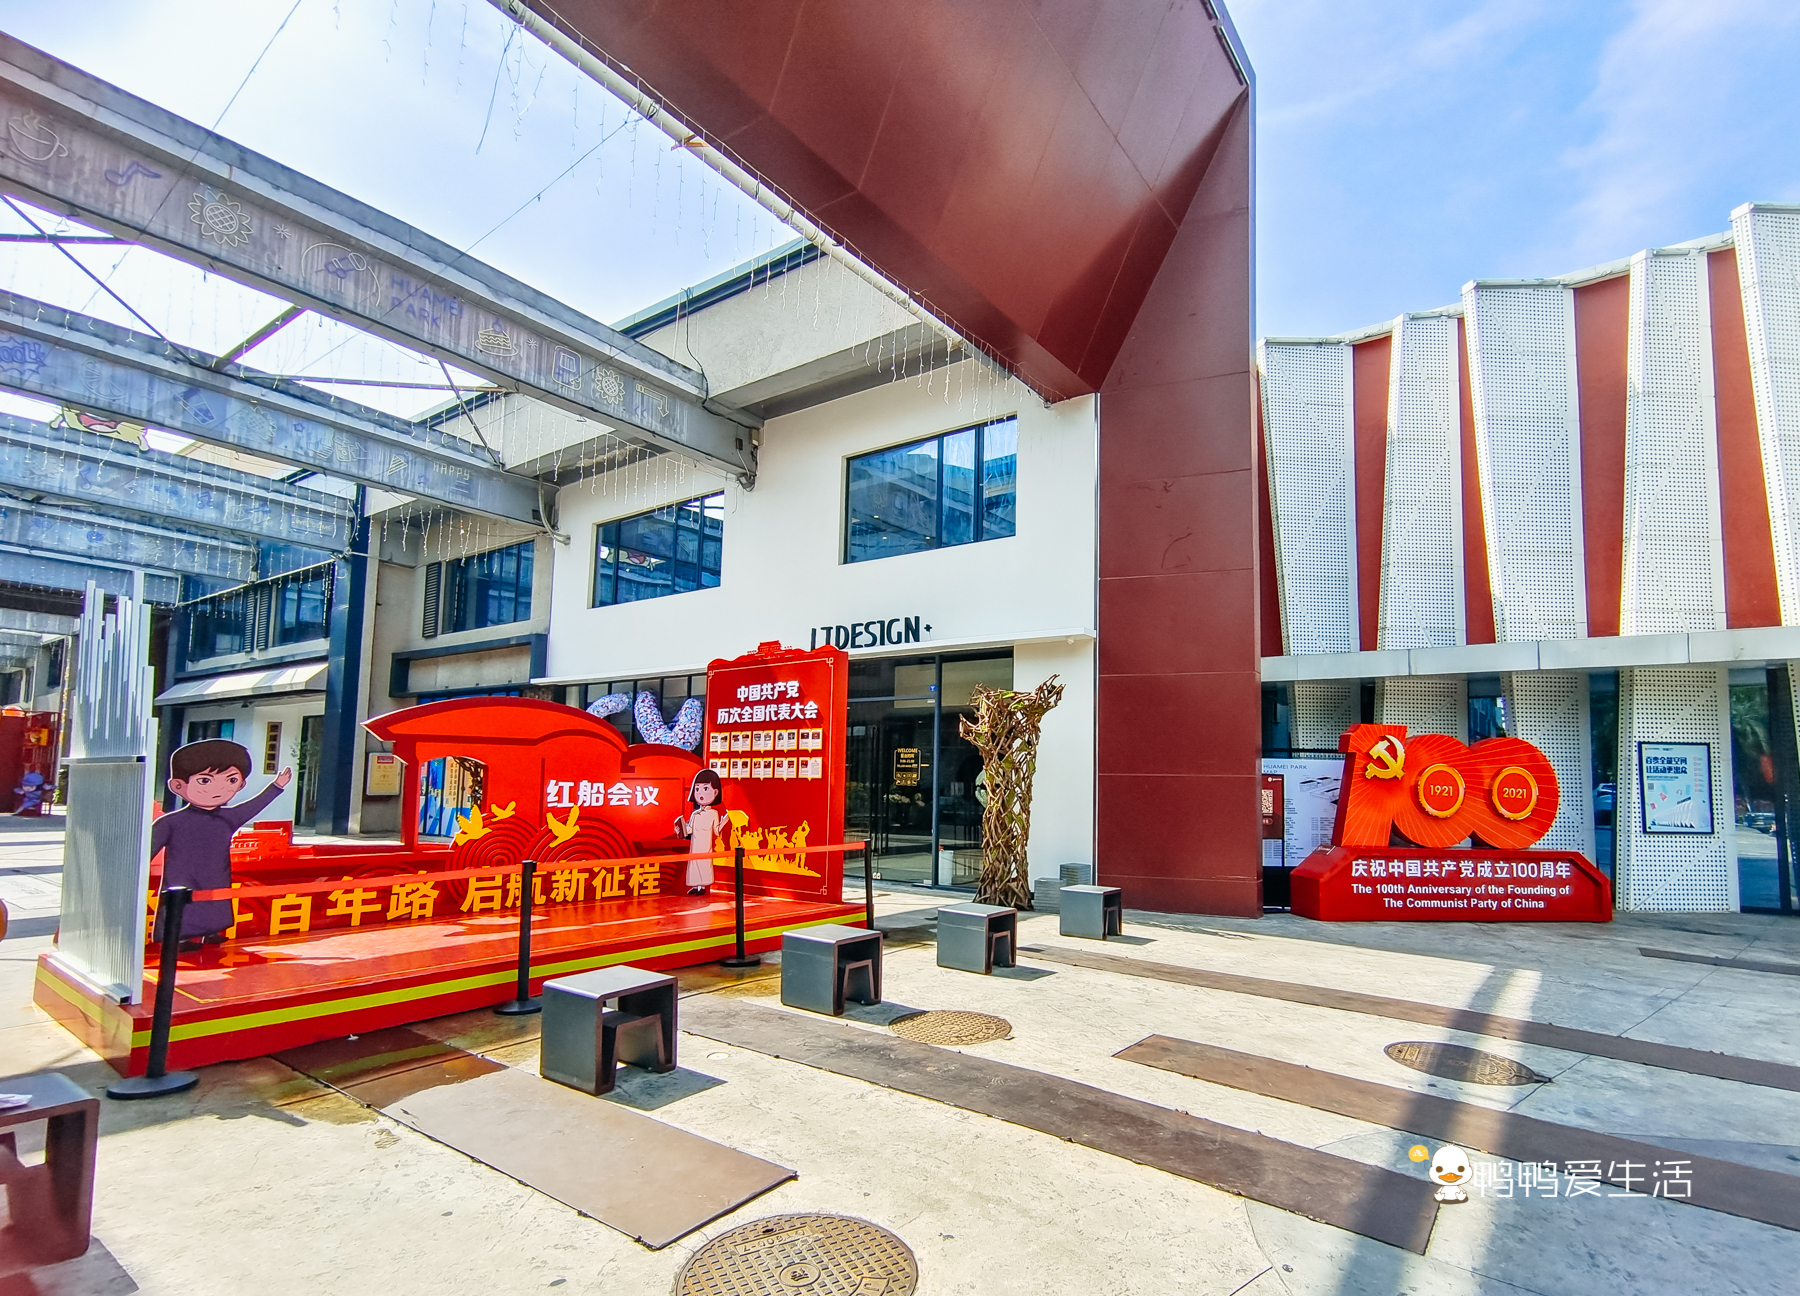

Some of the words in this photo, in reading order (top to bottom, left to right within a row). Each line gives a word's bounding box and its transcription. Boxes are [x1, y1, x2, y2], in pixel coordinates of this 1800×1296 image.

[391, 273, 464, 319] HUAMEI
[391, 296, 442, 329] PARK
[433, 462, 470, 481] HAPPY
[736, 681, 800, 702] 中国共产党
[716, 701, 819, 724] 历次全国代表大会
[546, 779, 660, 808] 红船会议
[1429, 783, 1454, 797] 1921
[1502, 786, 1528, 800] 2021
[1351, 859, 1571, 879] 庆祝中国共产党成立100周年
[1351, 884, 1372, 895] The
[1375, 884, 1405, 895] 100th
[1407, 884, 1472, 898] Anniversary
[1474, 884, 1486, 895] of
[1488, 884, 1505, 895] the
[1507, 884, 1556, 898] Founding
[1559, 884, 1570, 895] of
[1384, 898, 1404, 908] The
[1406, 898, 1468, 908] Communist
[1470, 898, 1498, 910] Party
[1501, 898, 1512, 908] of
[1514, 898, 1545, 908] China
